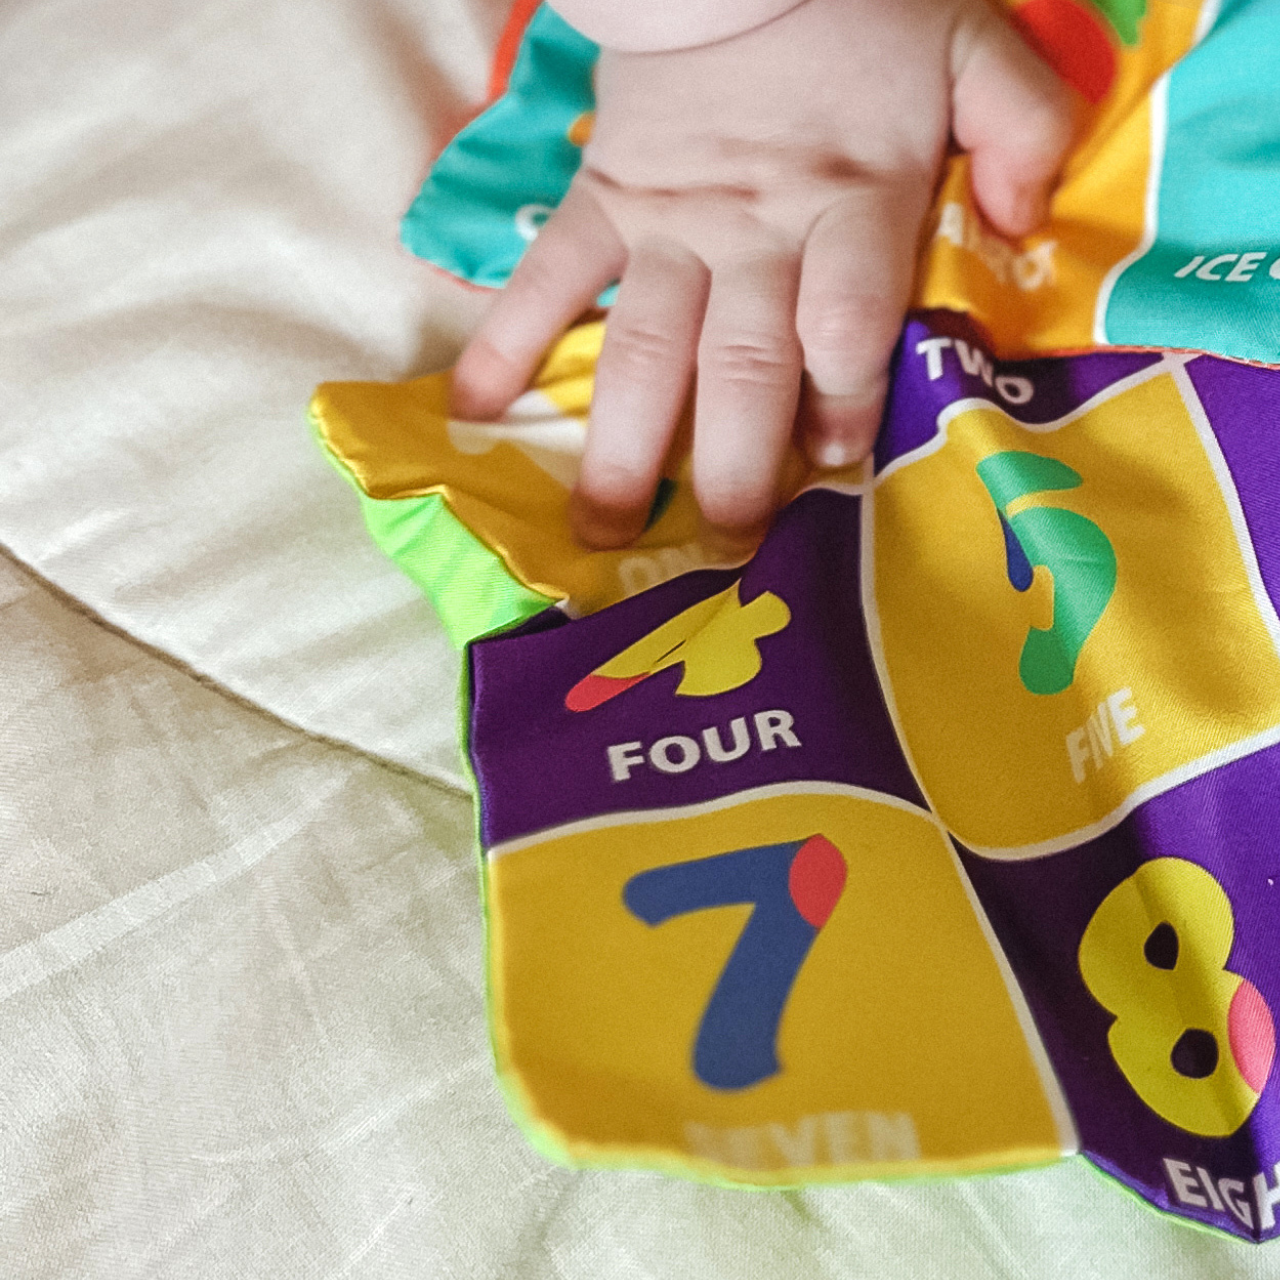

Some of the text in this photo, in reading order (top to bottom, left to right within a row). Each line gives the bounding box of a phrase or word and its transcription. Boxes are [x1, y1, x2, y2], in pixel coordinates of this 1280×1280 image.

[1174, 252, 1267, 282] ICE
[916, 337, 1034, 404] TWO
[607, 709, 801, 781] FOUR
[1066, 686, 1147, 784] FIVE
[622, 833, 847, 1091] 7
[1078, 856, 1276, 1139] 8
